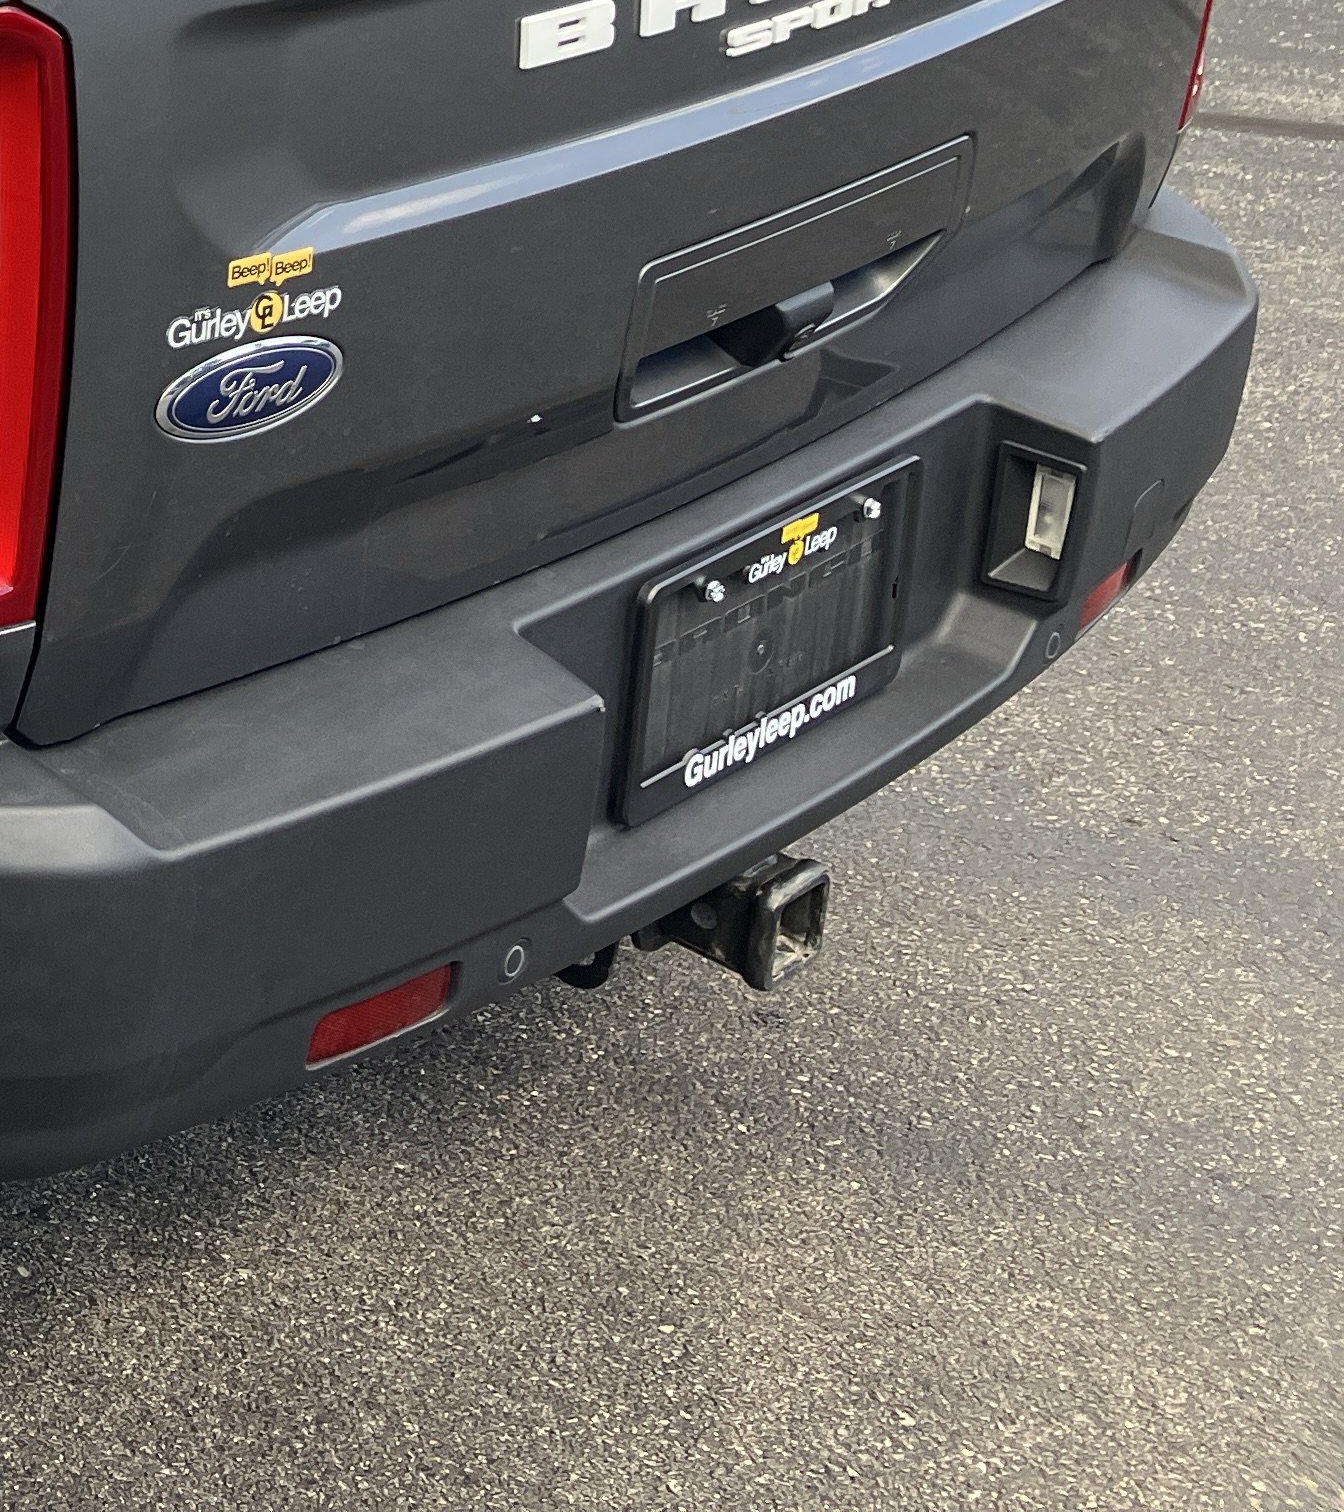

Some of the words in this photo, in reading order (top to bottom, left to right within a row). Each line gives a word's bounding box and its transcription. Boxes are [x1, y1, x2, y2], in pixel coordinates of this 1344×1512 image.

[230, 257, 271, 280] Beep!
[274, 253, 312, 276] Beep!
[167, 306, 251, 349] Gurley
[282, 286, 342, 324] Leep
[206, 360, 308, 424] Ford
[748, 552, 788, 583] Gurley
[804, 526, 837, 555] Leep
[684, 675, 857, 787] Gurleyleep.com
